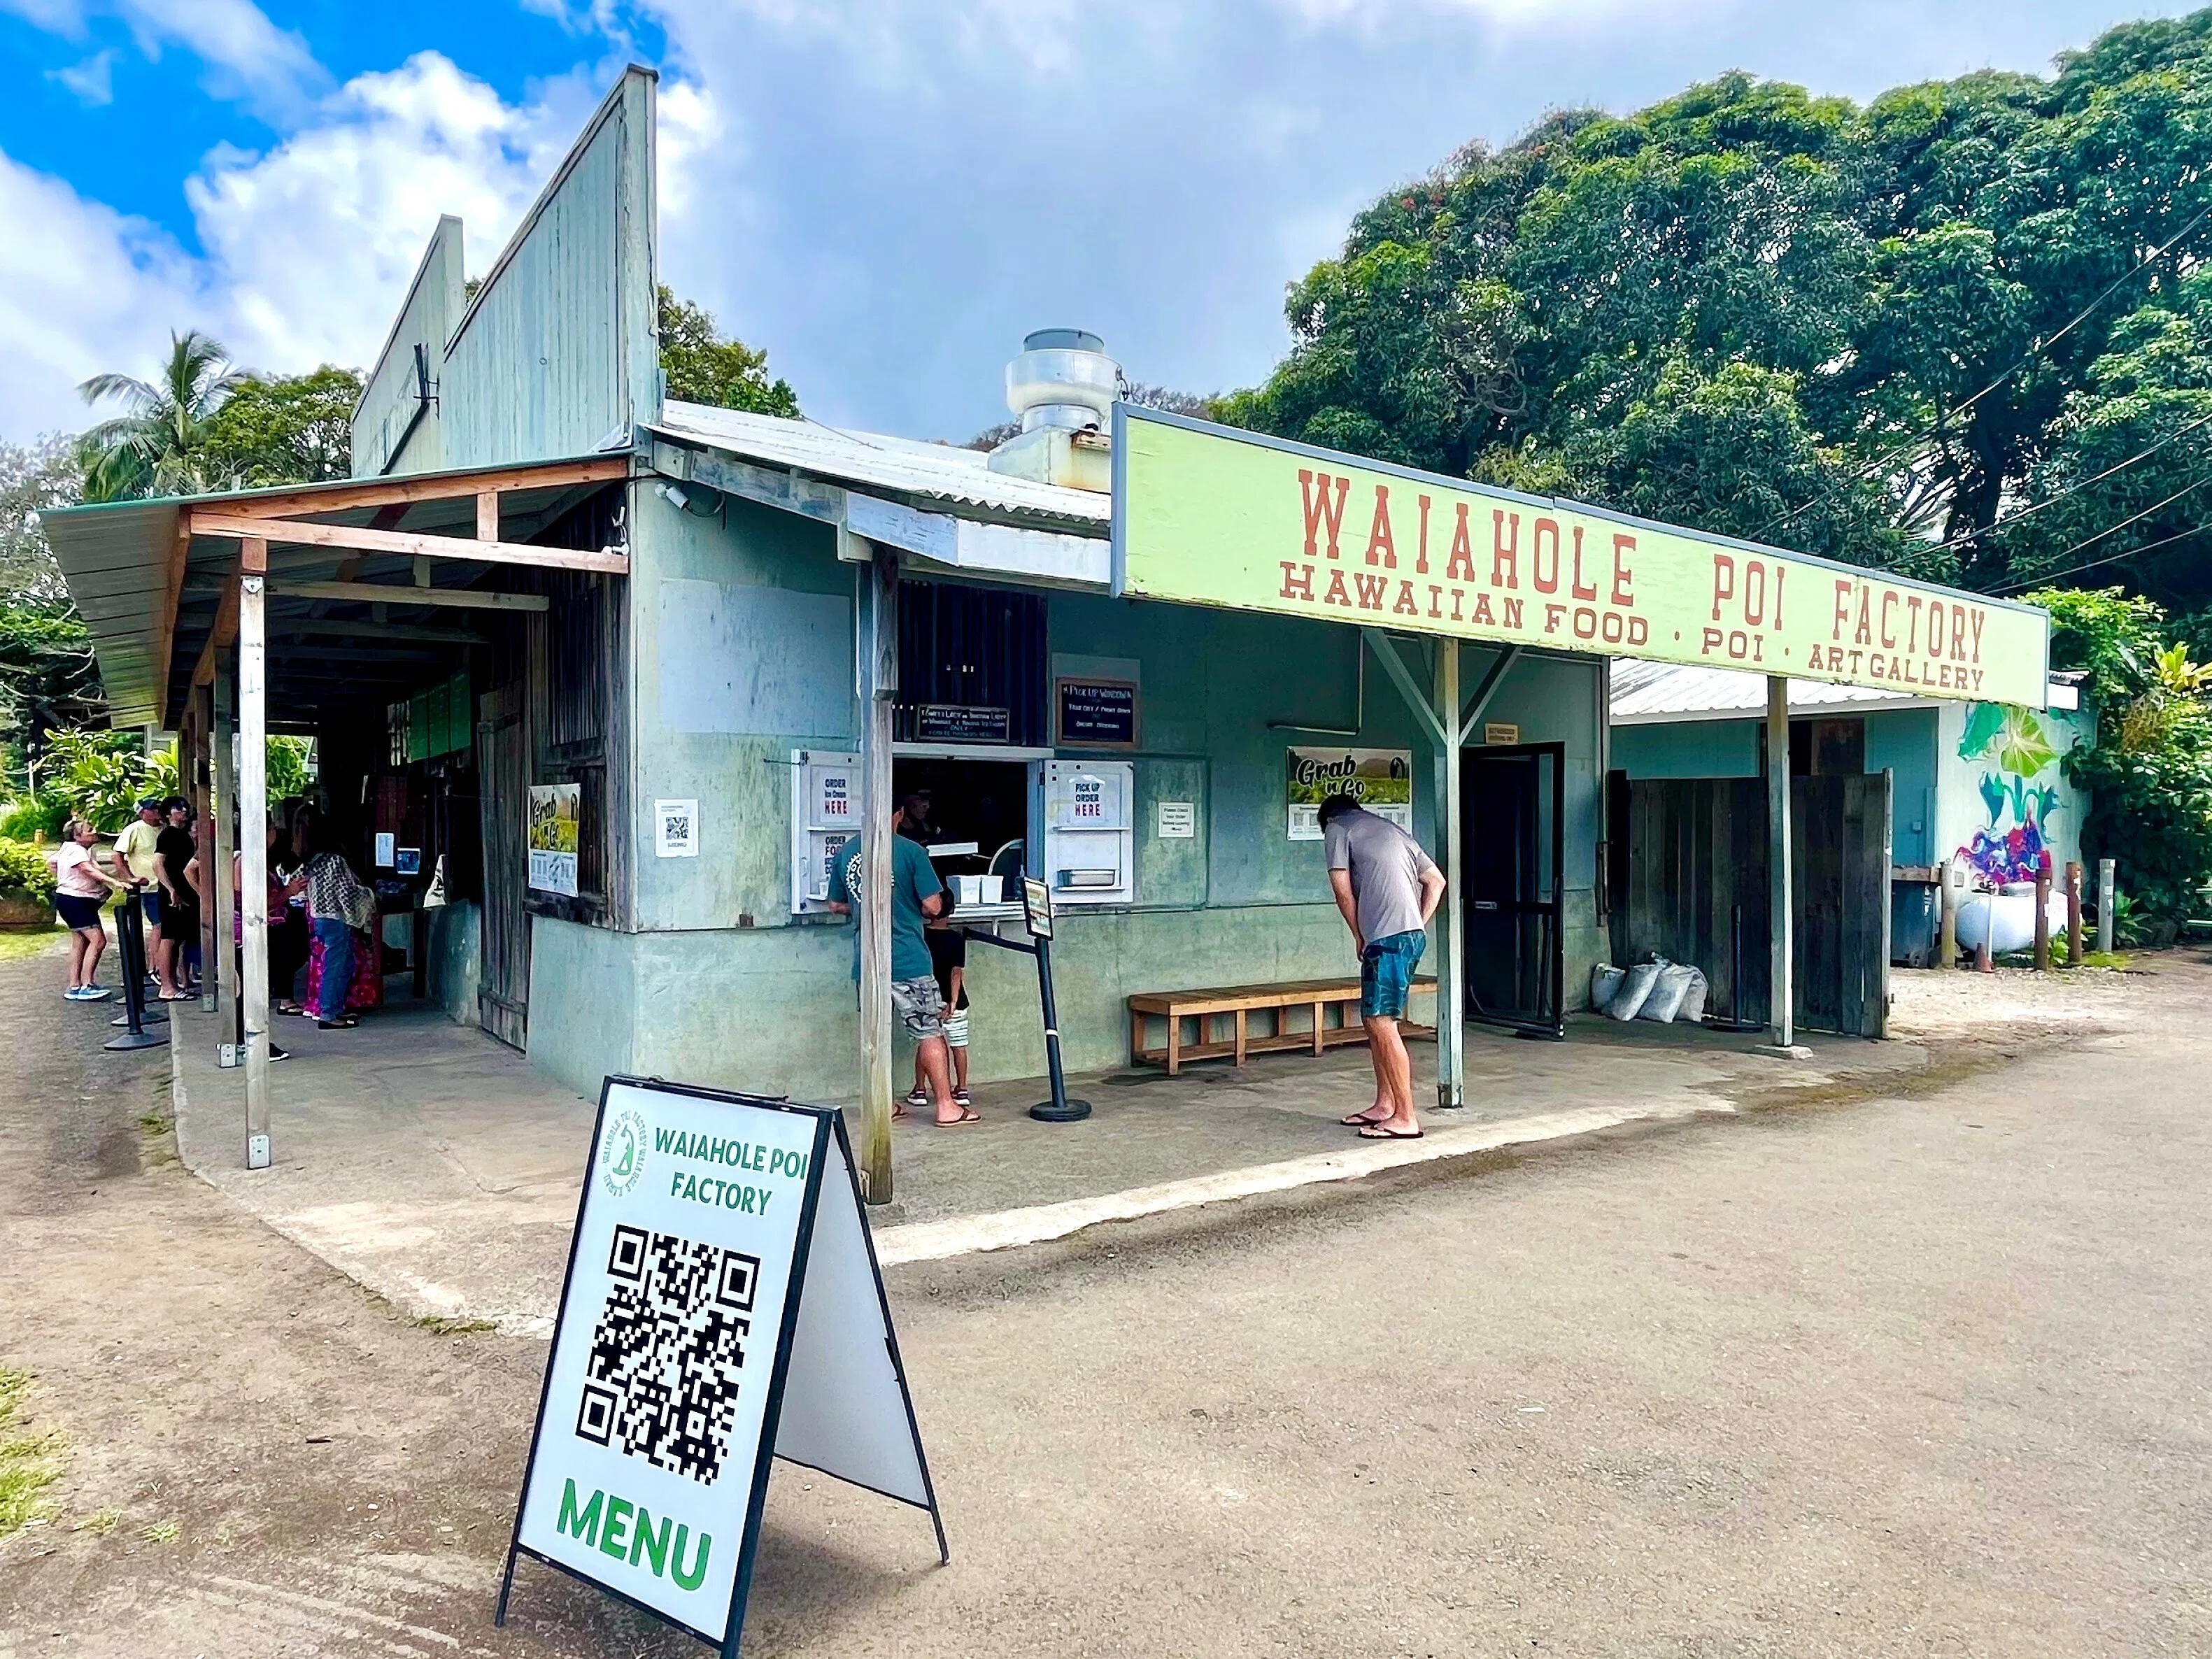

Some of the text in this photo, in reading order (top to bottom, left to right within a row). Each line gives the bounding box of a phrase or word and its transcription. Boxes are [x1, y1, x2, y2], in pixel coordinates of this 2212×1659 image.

[1298, 469, 1985, 664] WAIAHOLE POI FACTORY
[1279, 561, 1524, 629] HAWAIIAN
[1545, 604, 1648, 646] FOOD
[1702, 627, 1763, 662] POI
[825, 778, 846, 788] ORDER
[1075, 783, 1100, 792] PICK UP
[1298, 754, 1356, 788] Grab
[1341, 778, 1365, 797] Go
[533, 792, 556, 827] Grab
[825, 800, 847, 814] HERE
[1075, 804, 1100, 816] HERE
[825, 836, 846, 845] ORDER
[655, 1127, 808, 1180] WAIAHOLE POI
[671, 1171, 772, 1216] FACTORY
[556, 1477, 712, 1591] MENU
